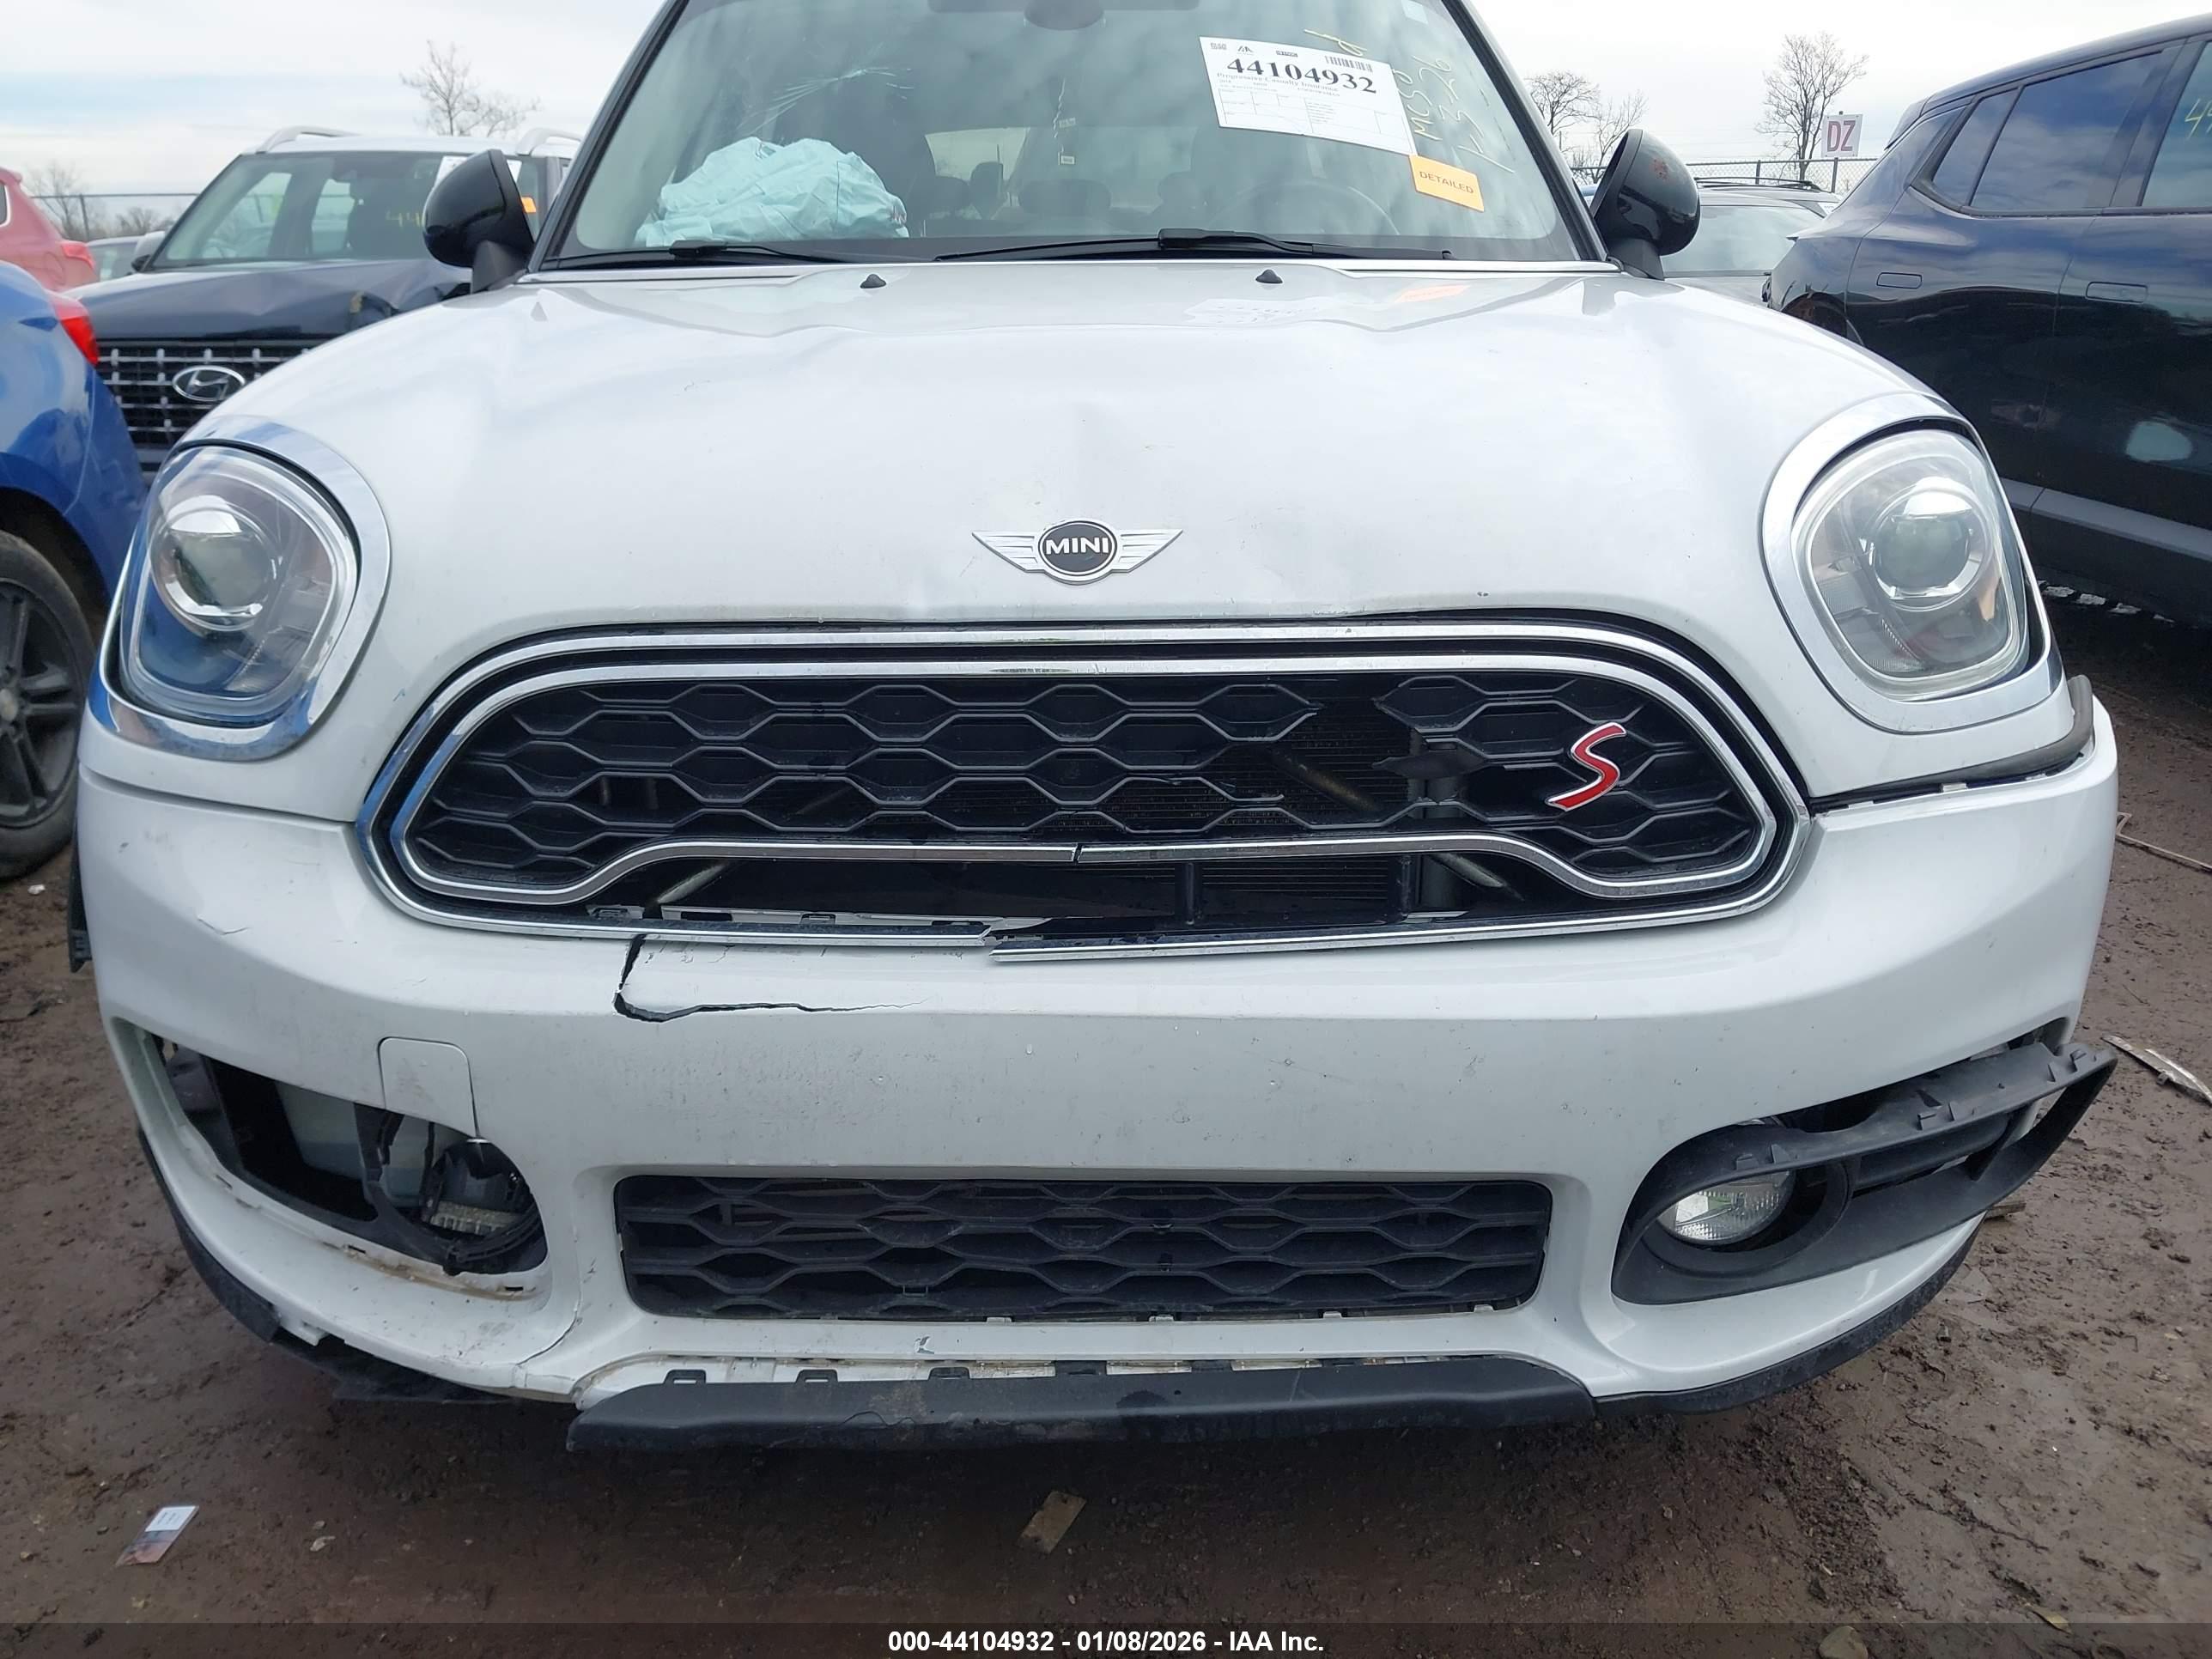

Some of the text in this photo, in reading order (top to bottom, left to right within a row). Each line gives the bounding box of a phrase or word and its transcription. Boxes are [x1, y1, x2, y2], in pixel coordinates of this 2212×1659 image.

[1227, 58, 1376, 94] 44104932
[1827, 119, 1856, 152] DZ
[1419, 171, 1474, 194] DETAILED
[1046, 537, 1109, 555] MINI
[1546, 721, 1626, 811] S
